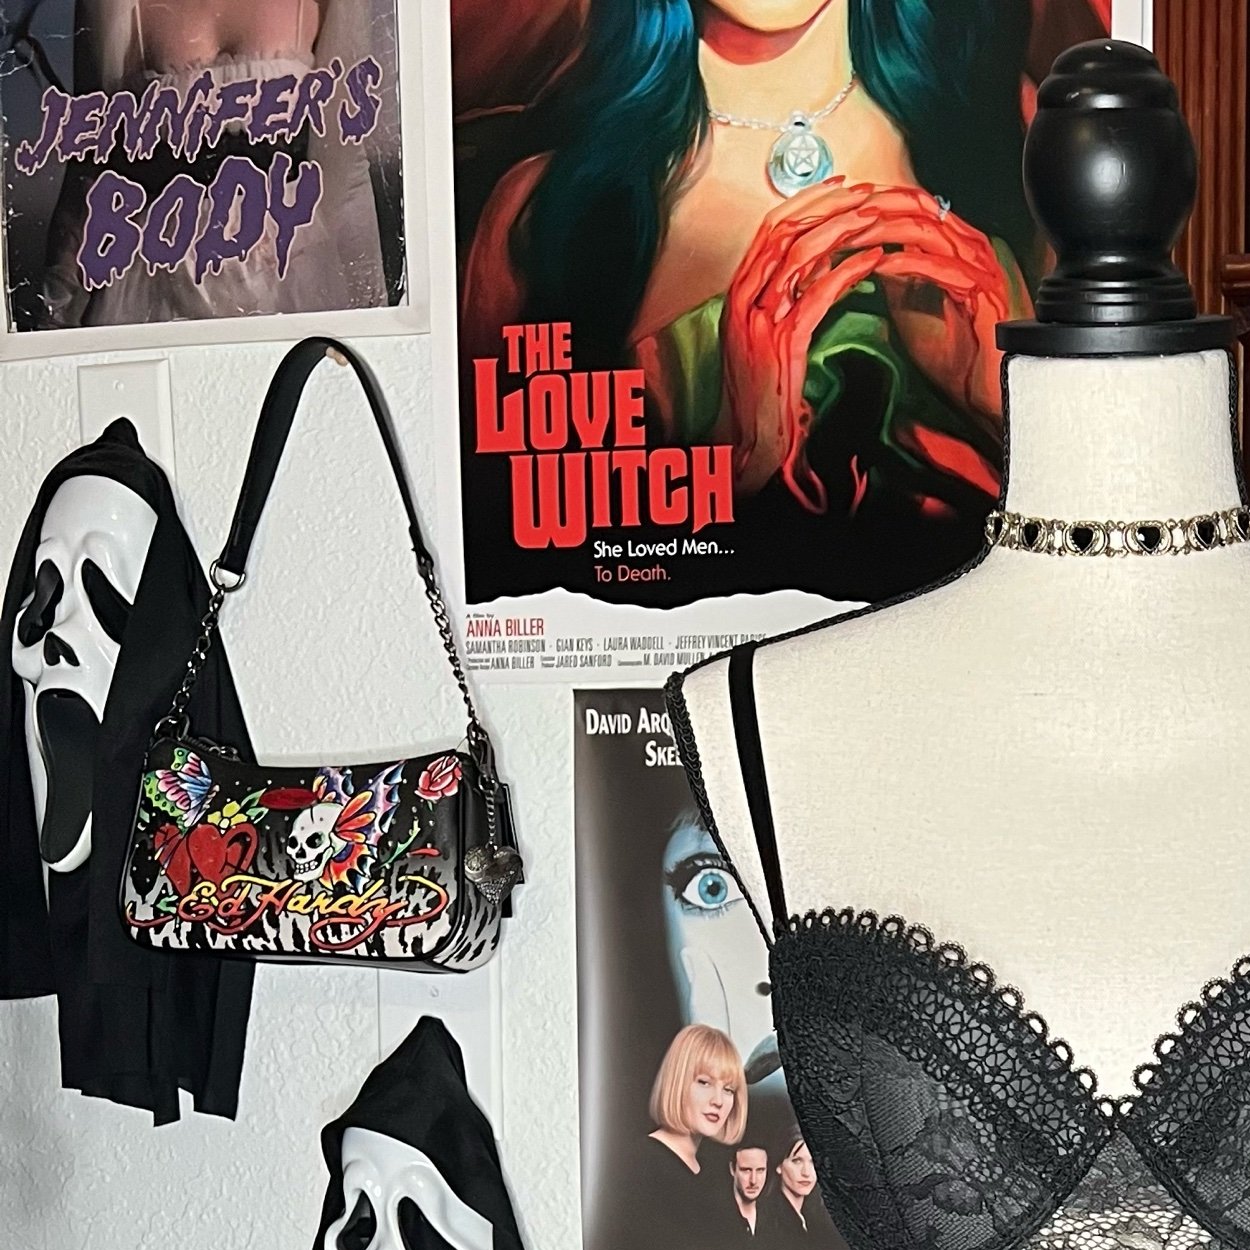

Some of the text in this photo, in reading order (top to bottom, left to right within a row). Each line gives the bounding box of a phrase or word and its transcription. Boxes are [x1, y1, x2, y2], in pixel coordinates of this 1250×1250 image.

[15, 55, 383, 175] JENNIFER'S
[77, 151, 323, 292] BODY
[502, 321, 572, 378] THE
[472, 358, 646, 454] LOVE
[509, 444, 735, 549] WITCH
[593, 538, 735, 558] She Loved Men...
[594, 564, 671, 582] To Death.
[465, 640, 507, 655] SAMANTHA
[508, 639, 546, 654] ROBINSON
[556, 638, 574, 652] GIAN
[576, 638, 594, 651] KEYS
[603, 637, 628, 651] LAURA
[629, 636, 664, 650] WADDELL
[675, 635, 707, 650] JEFFREY
[466, 618, 544, 638] ANNA BILLER
[491, 657, 511, 670] ANNA
[512, 656, 535, 670] BILLER
[555, 655, 578, 668] JARED
[580, 654, 612, 667] SANFORD
[654, 652, 675, 666] DAVID
[586, 708, 632, 735] DAVID
[178, 874, 449, 950] Ed Hardy
